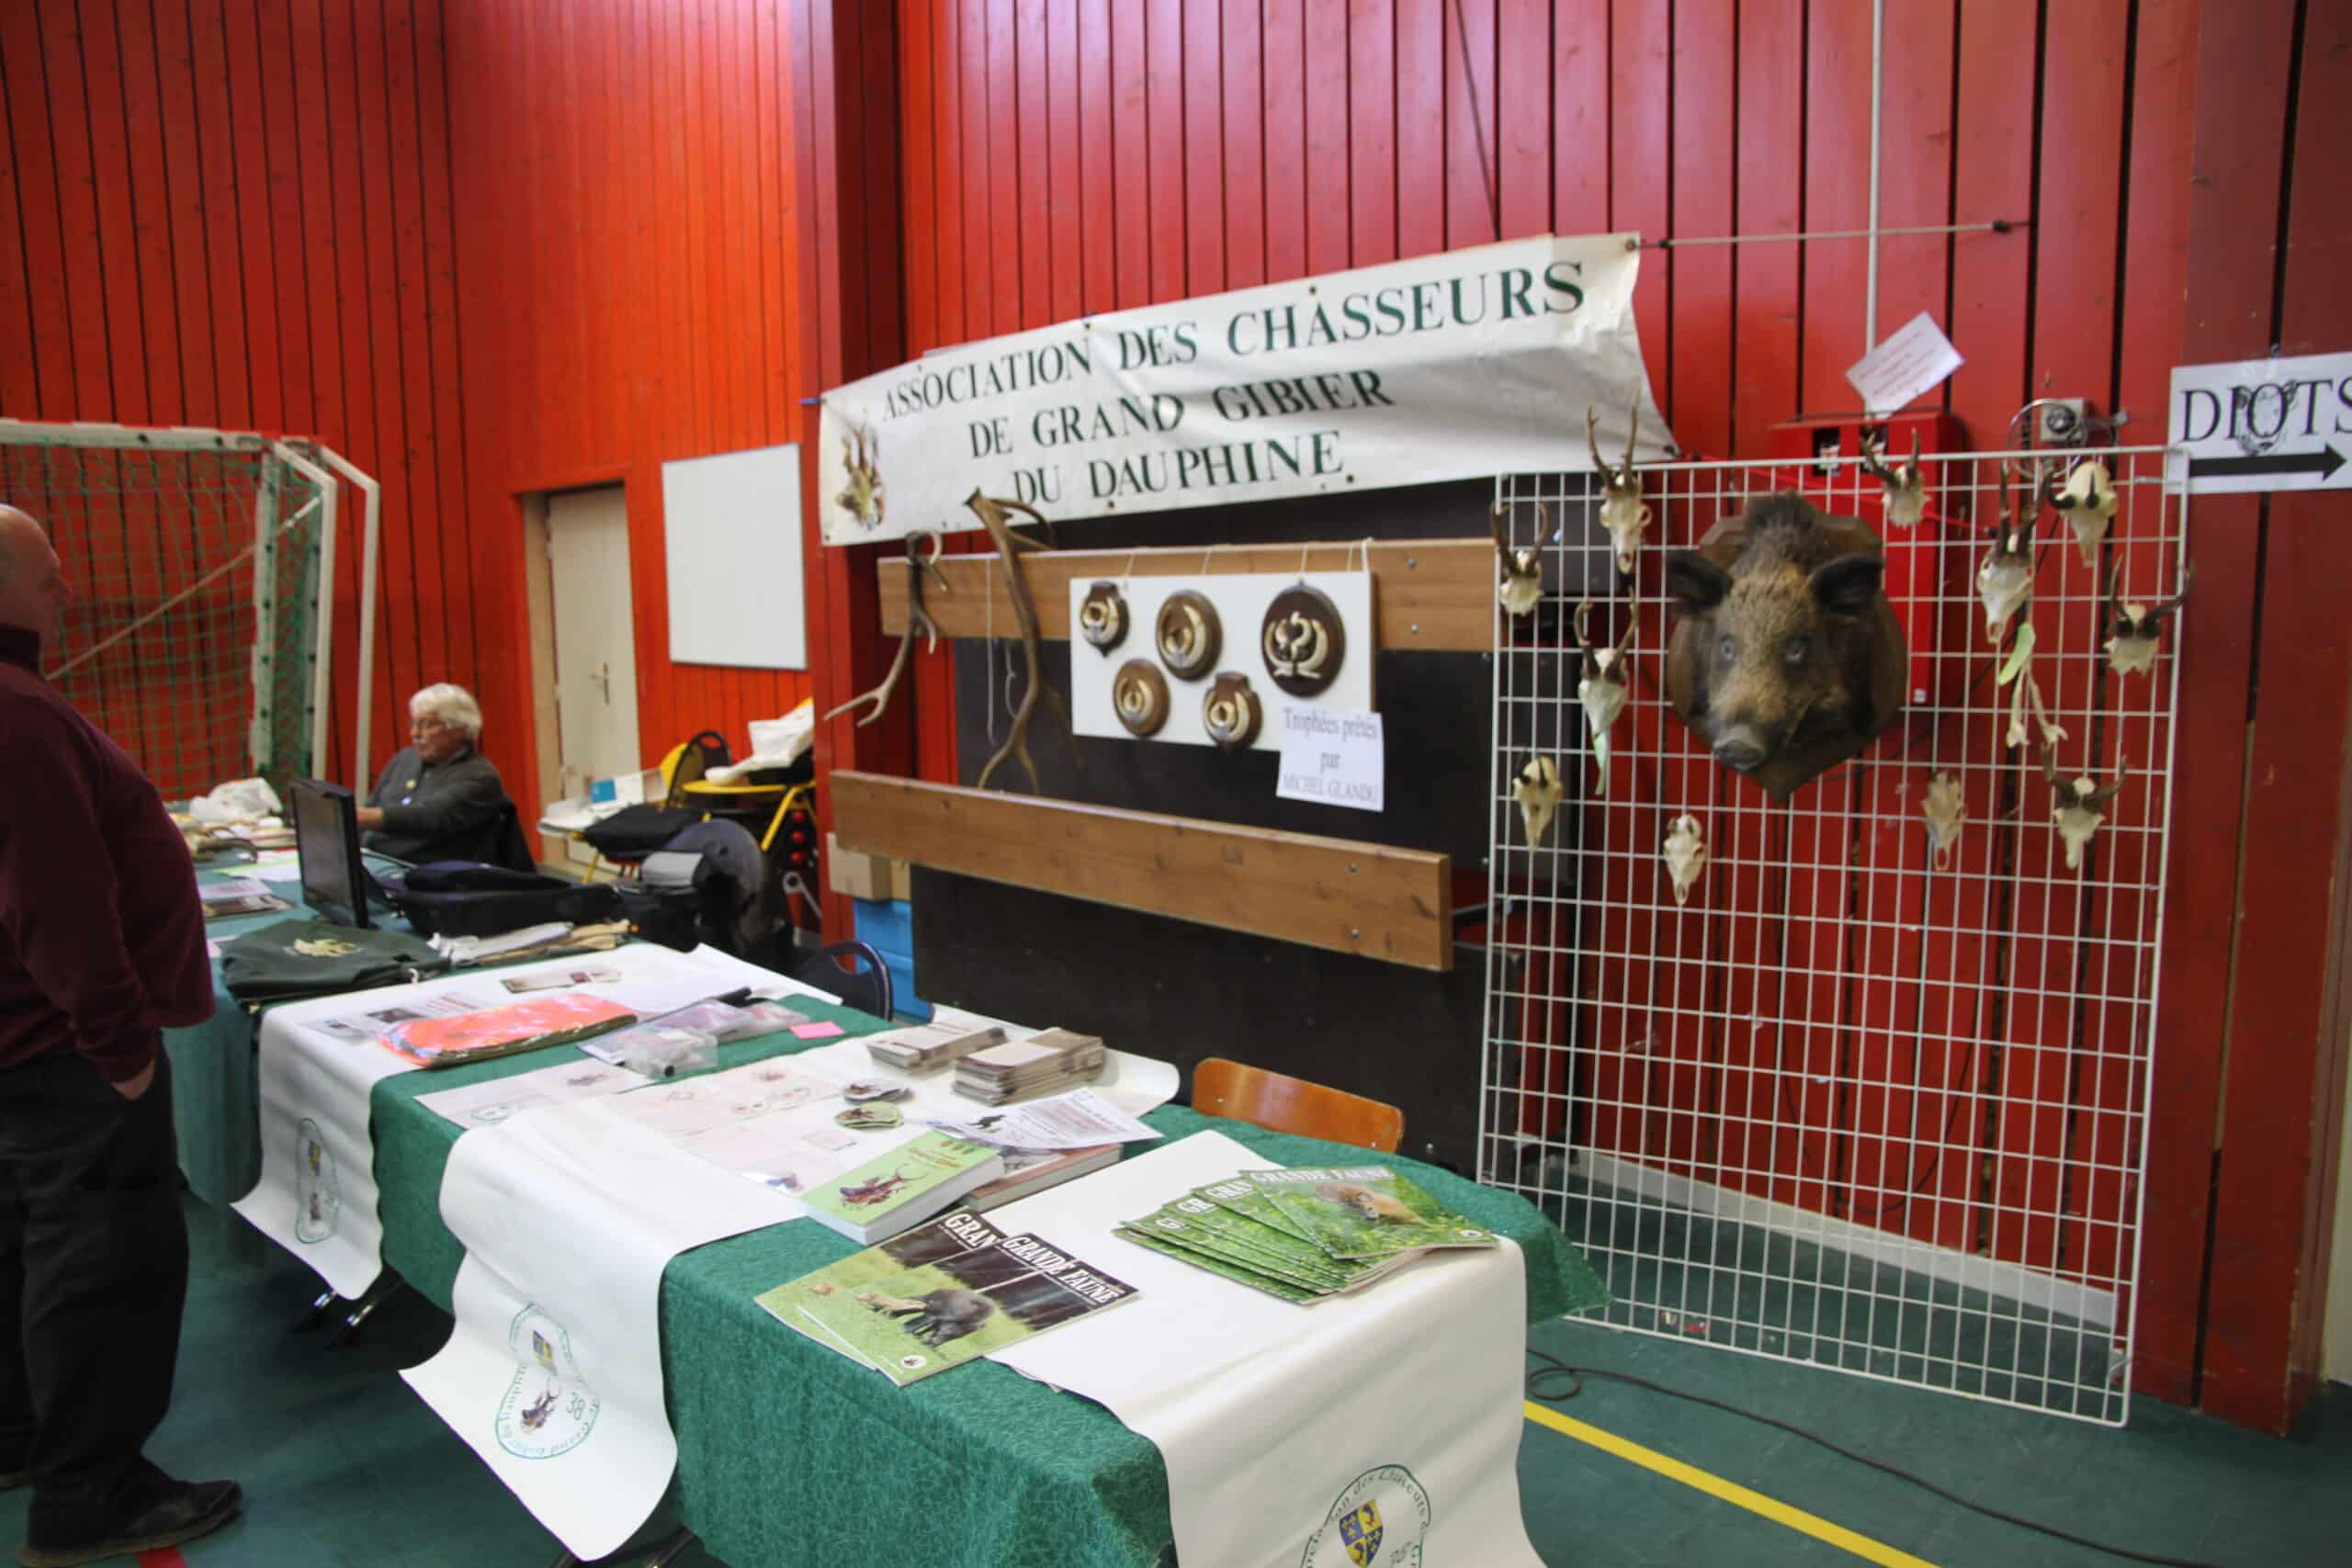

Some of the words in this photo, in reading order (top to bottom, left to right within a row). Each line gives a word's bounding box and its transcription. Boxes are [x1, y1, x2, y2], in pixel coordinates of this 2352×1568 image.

[882, 336, 1092, 423] ASSOCIATION
[1118, 322, 1197, 370] DES
[1227, 260, 1585, 355] CHASSEURS
[969, 417, 1013, 459] DE
[1032, 393, 1184, 448] GRAND
[1212, 367, 1396, 422] GIBIER
[1012, 461, 1062, 506] DU
[1090, 430, 1344, 500] DAUPHINE
[1320, 752, 1341, 773] par
[1057, 1269, 1125, 1303] FAUNE
